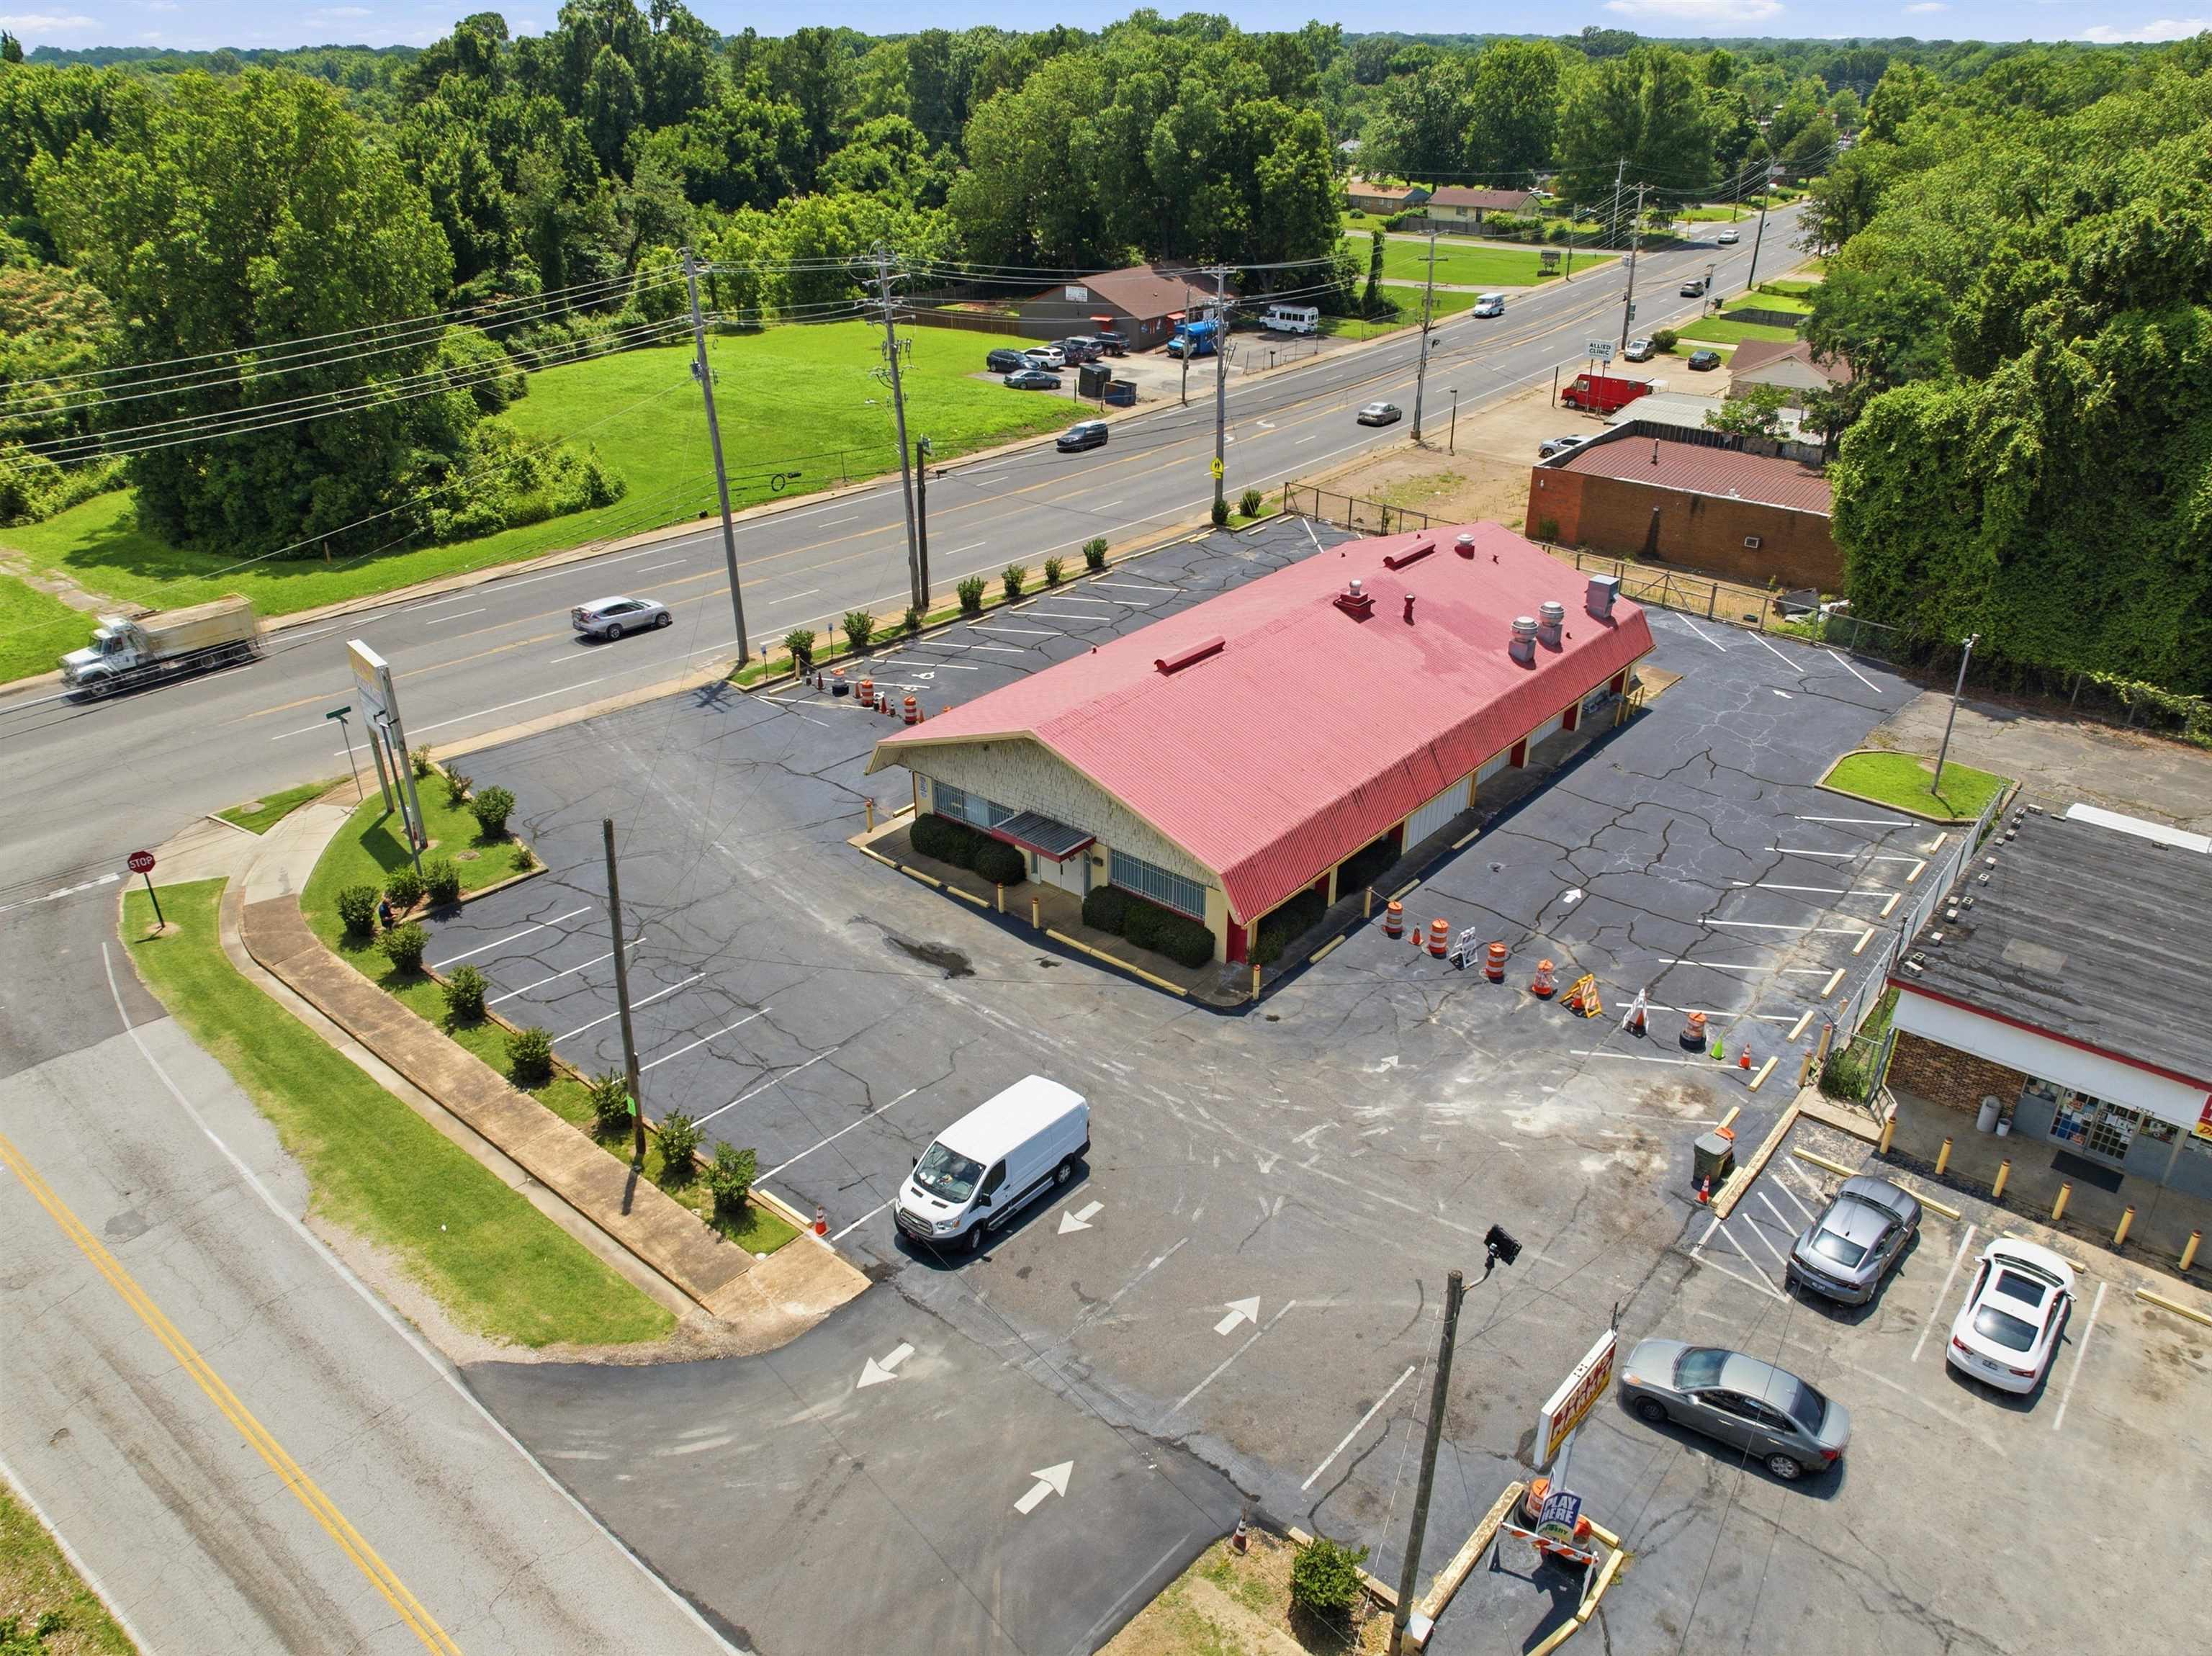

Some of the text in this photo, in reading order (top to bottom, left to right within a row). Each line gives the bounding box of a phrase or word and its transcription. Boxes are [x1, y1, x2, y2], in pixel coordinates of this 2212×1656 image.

[129, 856, 153, 868] STOP
[1545, 1495, 1577, 1511] PLAY
[1541, 1508, 1574, 1524] HERE
